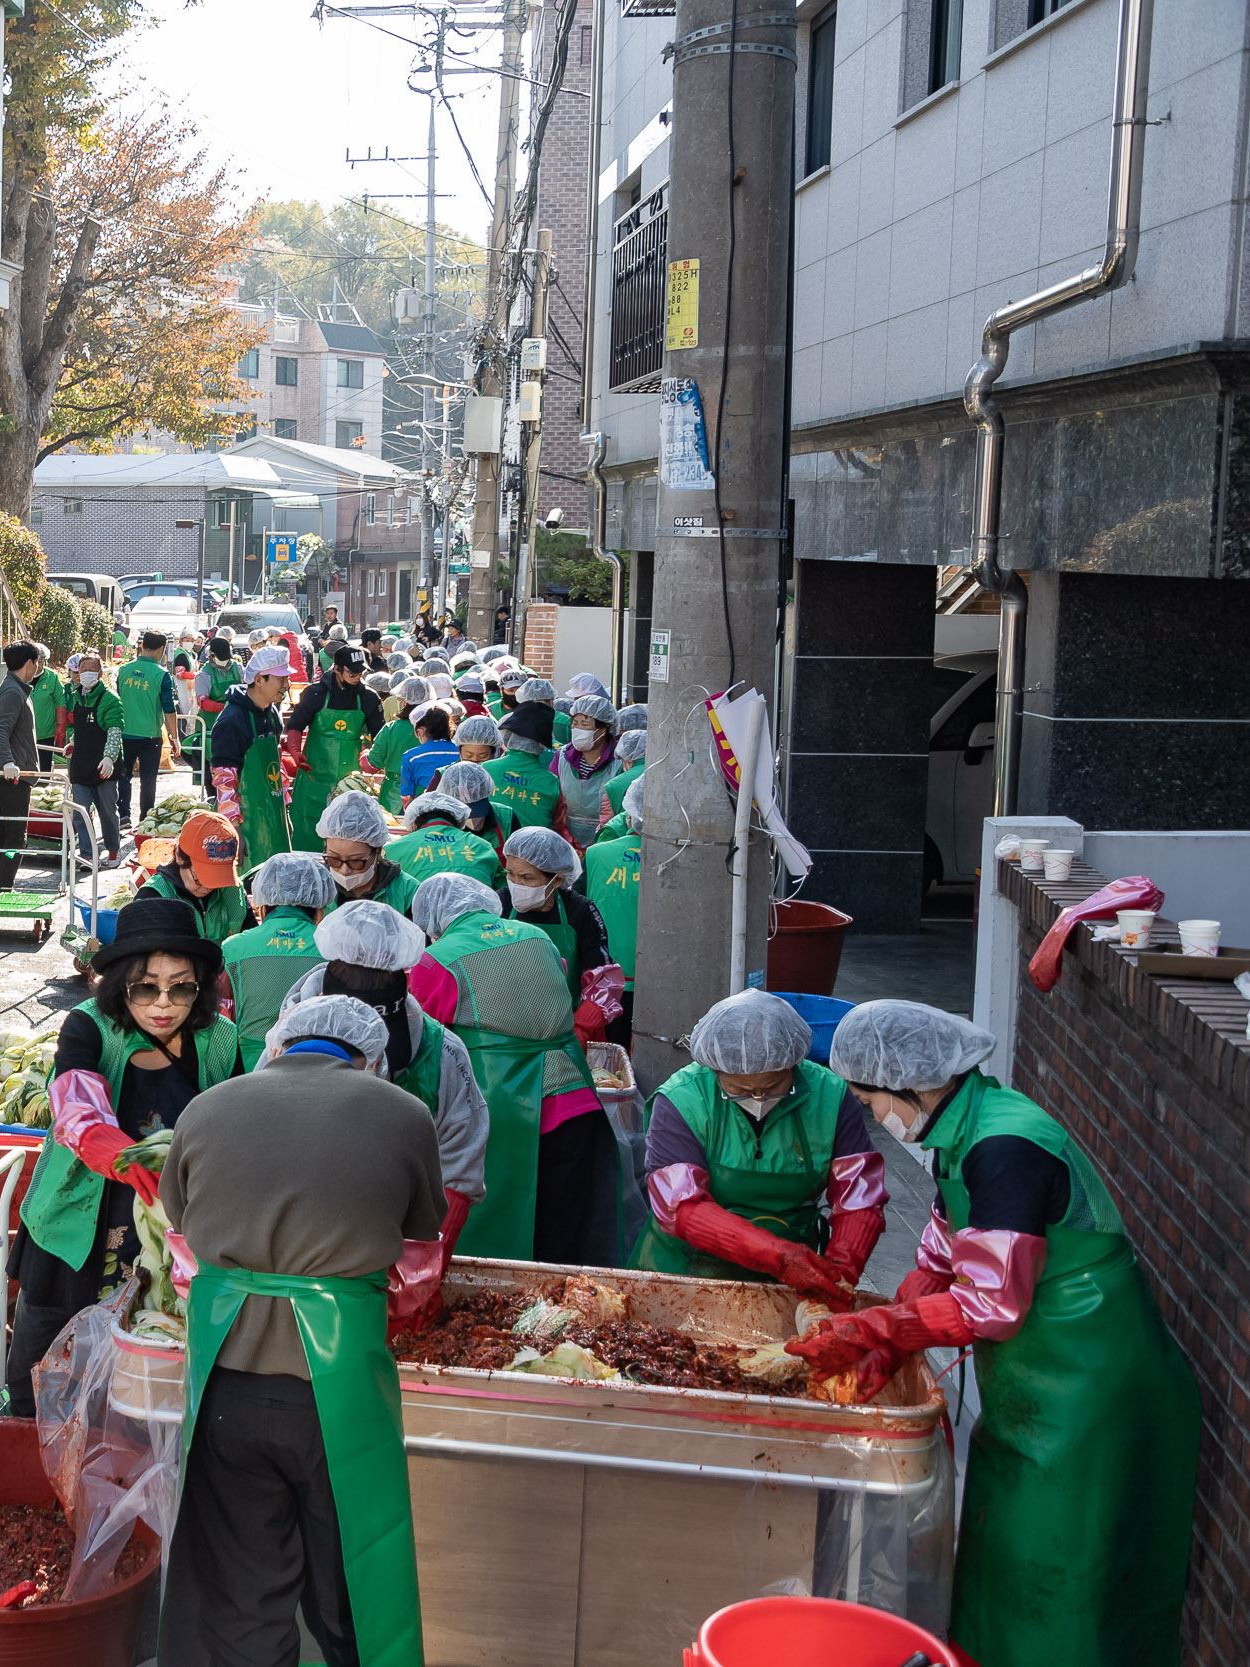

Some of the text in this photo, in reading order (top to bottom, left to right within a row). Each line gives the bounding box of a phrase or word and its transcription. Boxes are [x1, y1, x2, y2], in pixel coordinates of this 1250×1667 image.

[672, 281, 689, 293] 822
[674, 517, 703, 527] 이삿짐
[270, 537, 295, 545] 주차장
[124, 677, 149, 691] 새마을
[501, 773, 528, 786] SMU
[501, 786, 540, 805] 새마을
[424, 834, 456, 843] SMU
[413, 845, 476, 863] 새마을
[266, 937, 306, 949] 새마을
